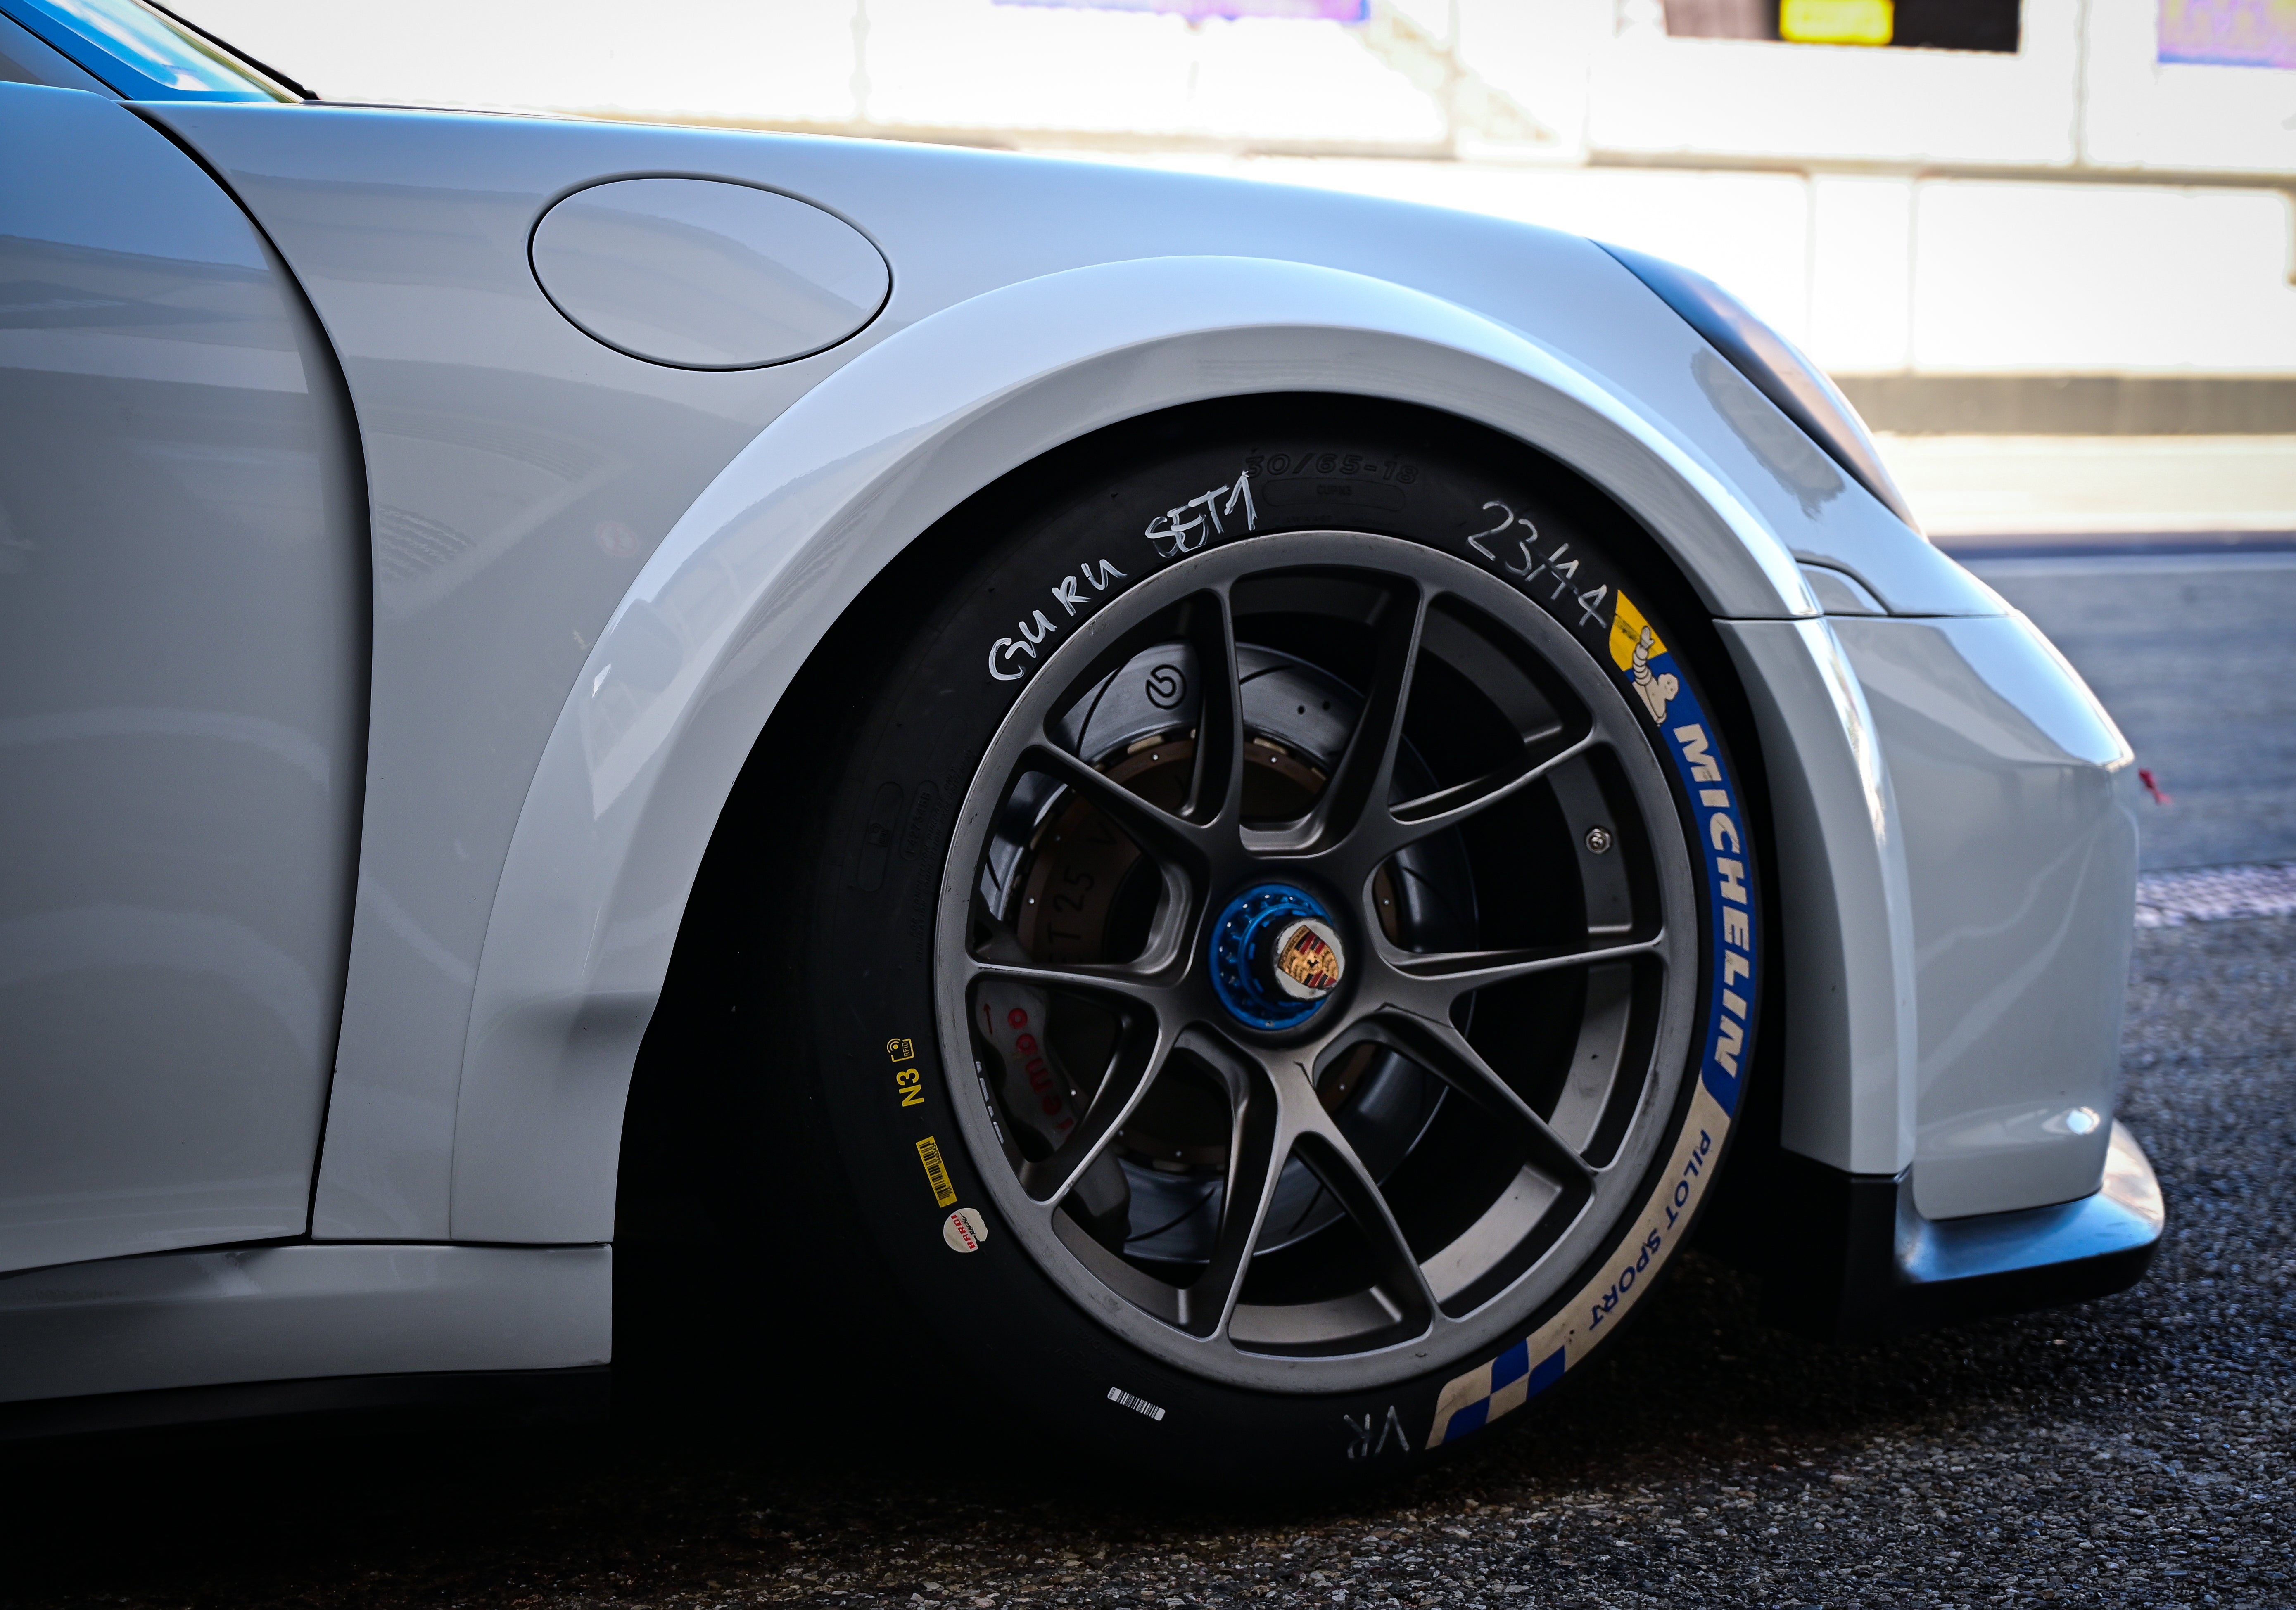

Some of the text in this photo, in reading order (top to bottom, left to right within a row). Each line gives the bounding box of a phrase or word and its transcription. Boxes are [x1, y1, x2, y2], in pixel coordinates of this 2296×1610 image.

[988, 558, 1128, 681] GURU
[1673, 724, 1750, 1079] MICHELIN
[896, 1068, 925, 1107] N3
[902, 1041, 910, 1057] RFID
[1008, 1007, 1074, 1131] rembo
[951, 1214, 976, 1249] BARDI
[1589, 1129, 1711, 1331] PILOT SPORT
[1343, 1405, 1410, 1459] VR
